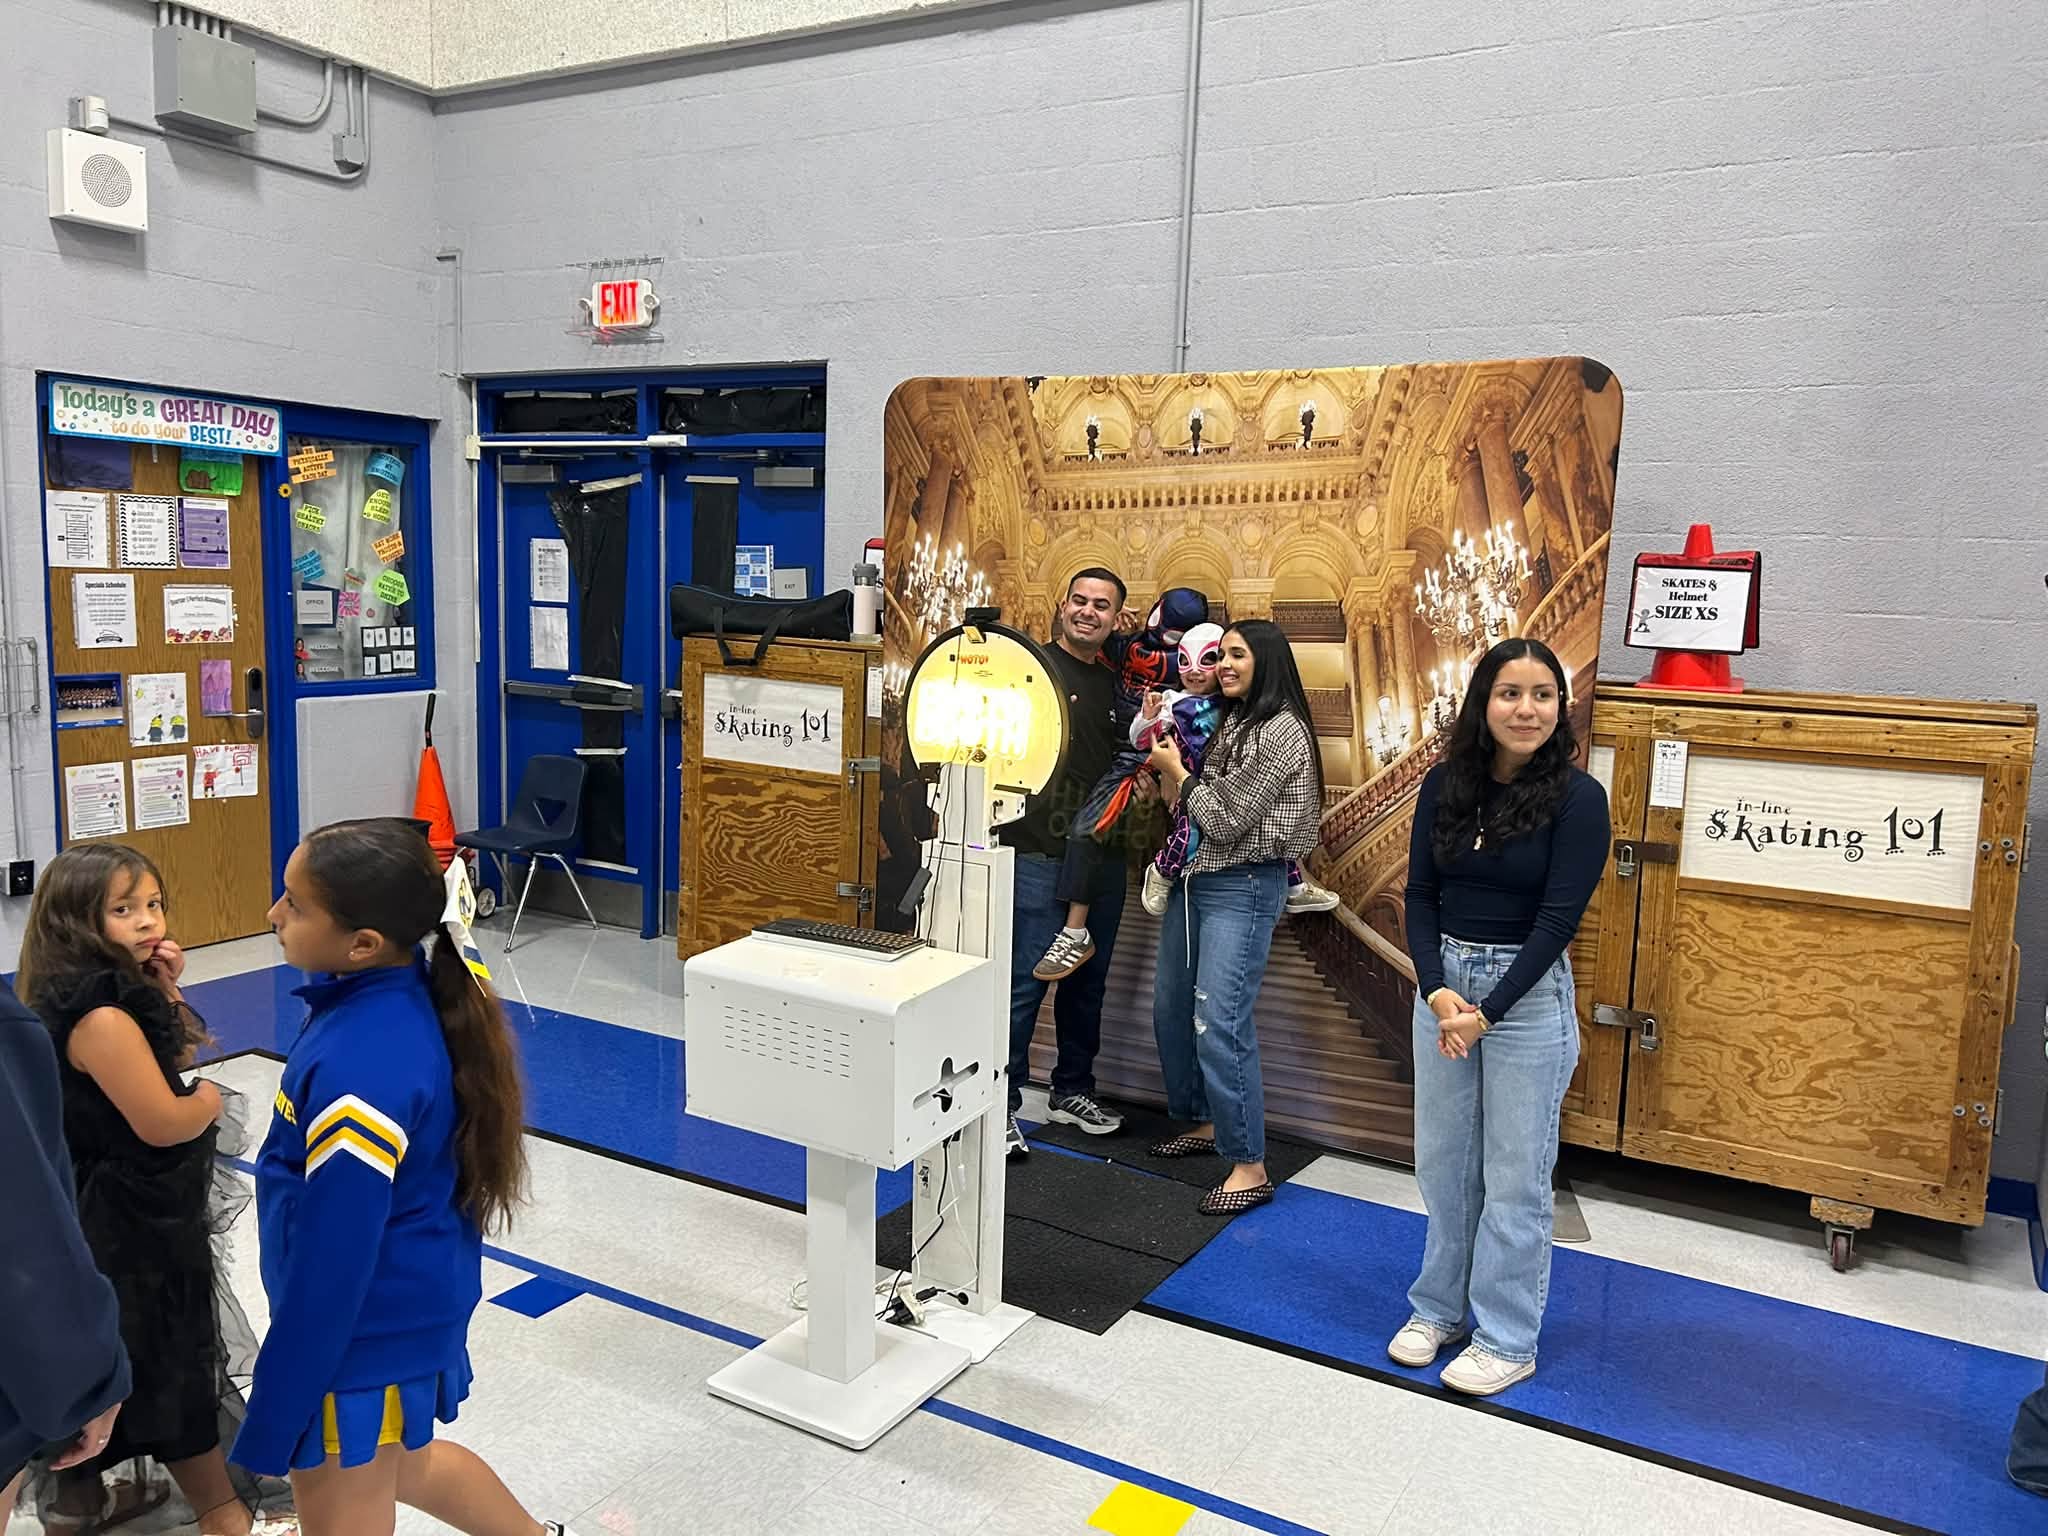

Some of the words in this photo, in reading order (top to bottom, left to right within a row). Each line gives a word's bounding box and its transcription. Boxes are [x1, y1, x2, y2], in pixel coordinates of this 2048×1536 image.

[601, 282, 639, 324] EXIT
[59, 385, 137, 418] Today's
[142, 400, 155, 417] a
[160, 399, 226, 425] GREAT
[231, 405, 274, 437] DAY
[111, 421, 127, 433] to
[131, 421, 149, 436] do
[154, 423, 186, 439] your
[189, 425, 231, 445] BEST!
[1661, 577, 1706, 589] SKATES
[1708, 579, 1718, 592] &
[1668, 591, 1708, 602] Helmet
[1655, 604, 1692, 619] SIZE
[1694, 606, 1718, 621] XS
[714, 711, 793, 747] Skating
[800, 708, 831, 742] 101
[195, 745, 219, 758] HAVE
[1736, 796, 1792, 815] in-line
[1705, 808, 1868, 862] Skating
[1883, 806, 1946, 857] 101
